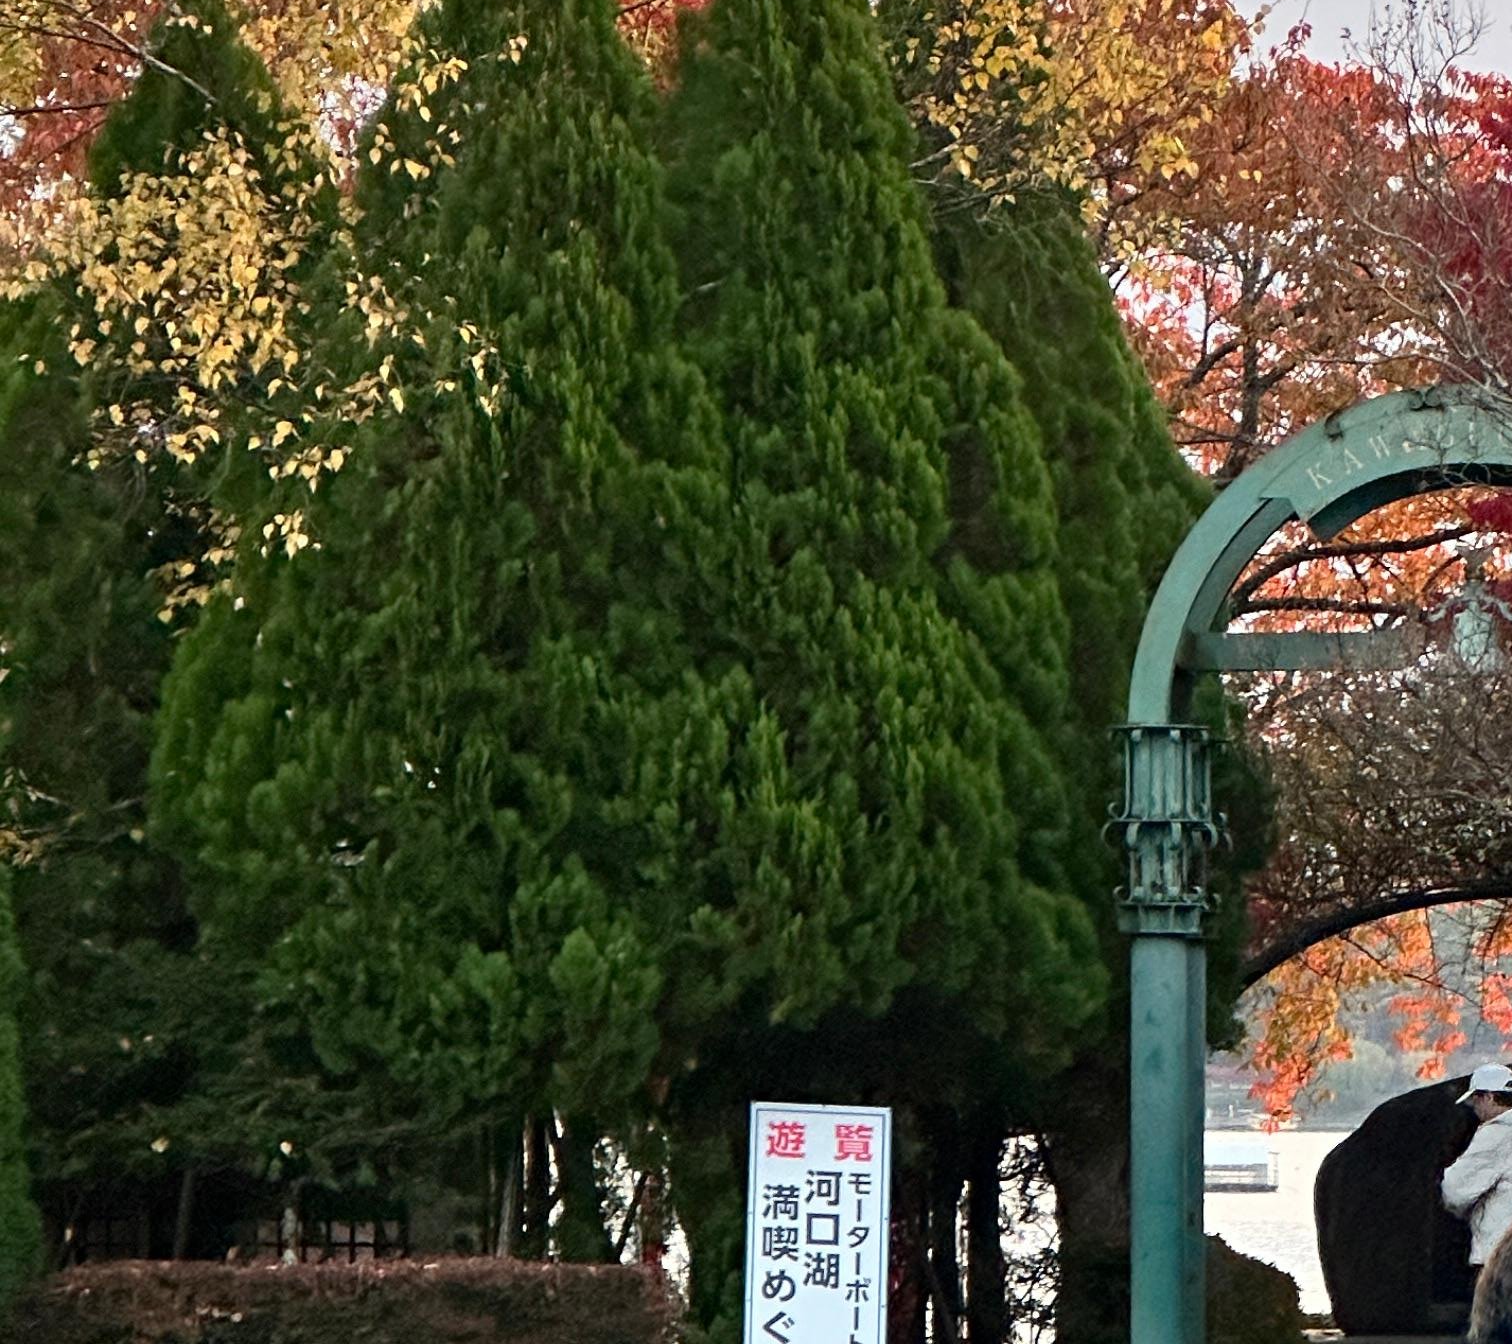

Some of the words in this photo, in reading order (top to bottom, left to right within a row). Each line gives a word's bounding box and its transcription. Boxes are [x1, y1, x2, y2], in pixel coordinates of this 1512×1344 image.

[766, 1121, 873, 1162] 遊覧
[803, 1170, 843, 1289] 河口湖
